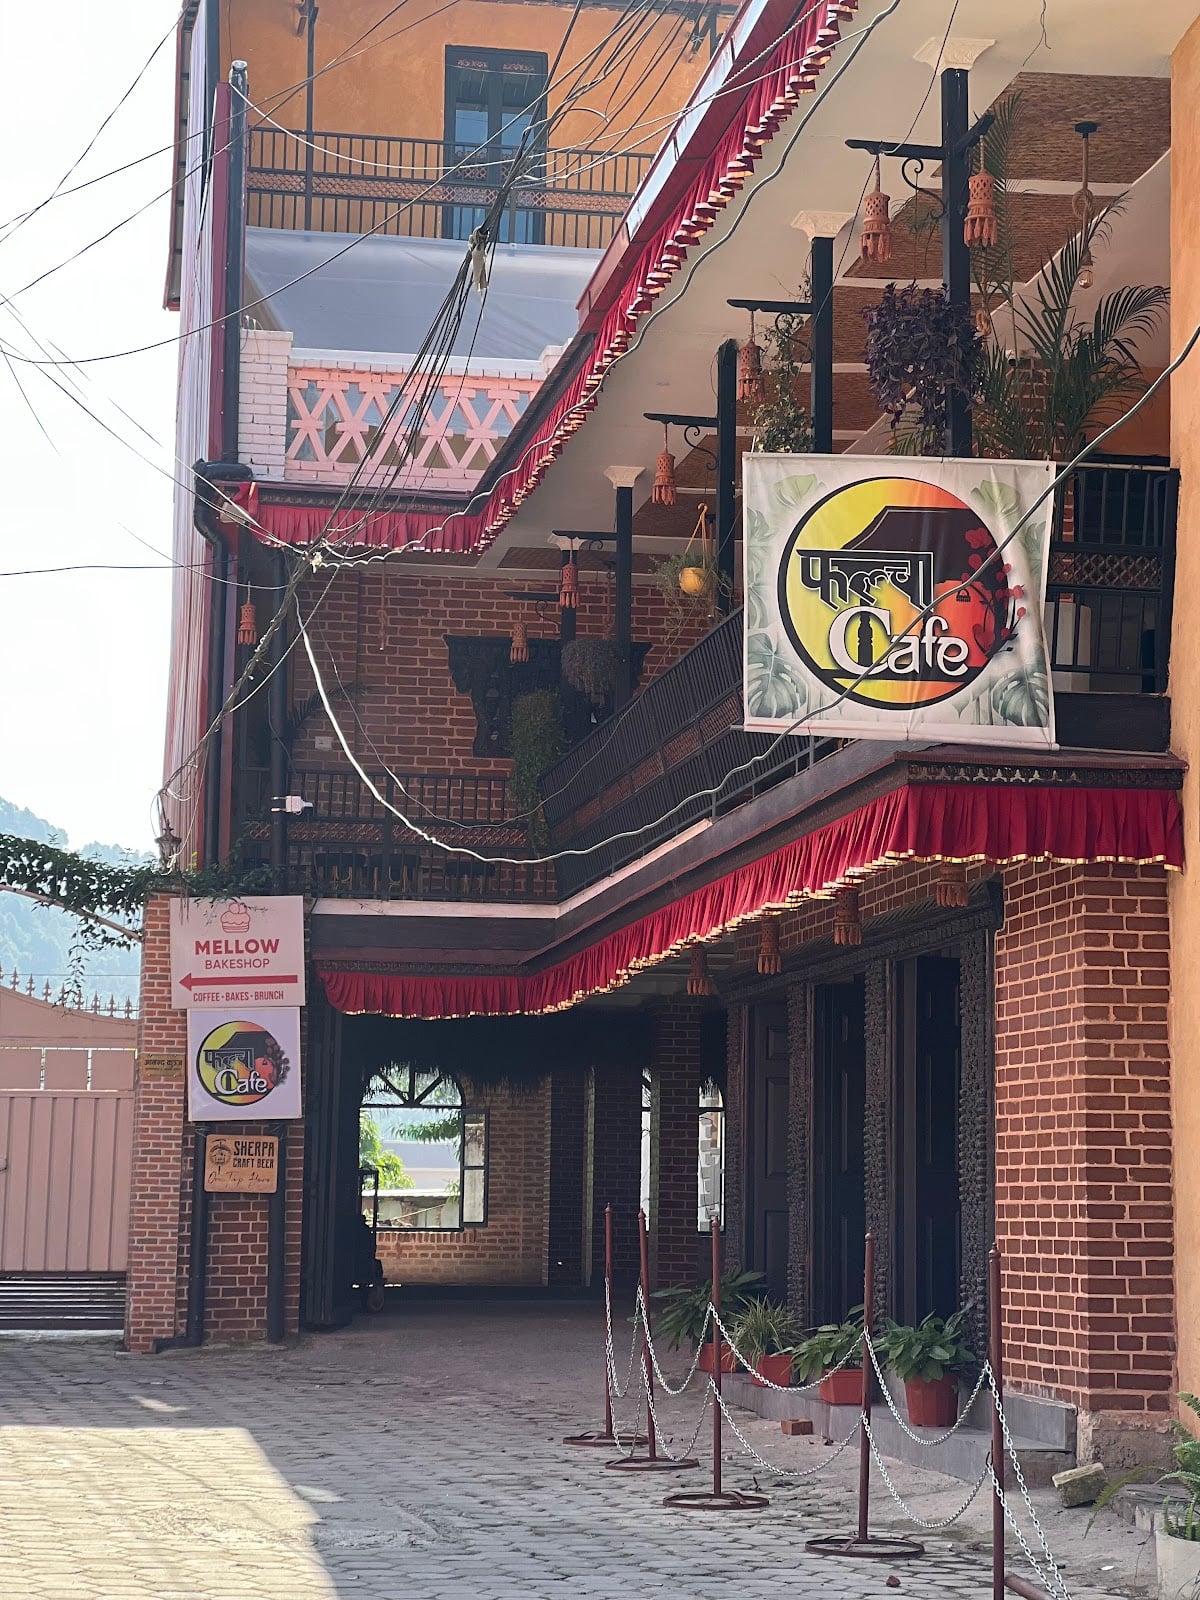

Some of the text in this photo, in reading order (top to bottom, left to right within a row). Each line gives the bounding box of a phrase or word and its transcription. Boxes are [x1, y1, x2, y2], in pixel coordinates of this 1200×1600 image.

[829, 605, 969, 676] Cafe
[195, 938, 280, 955] MELLOW
[205, 958, 270, 970] BAKESHOP
[193, 990, 284, 1002] COFFEE BAKES BRUNCH
[215, 1069, 268, 1095] Cafe
[233, 1140, 275, 1157] SHERPA
[232, 1157, 274, 1168] CRAFT BEER
